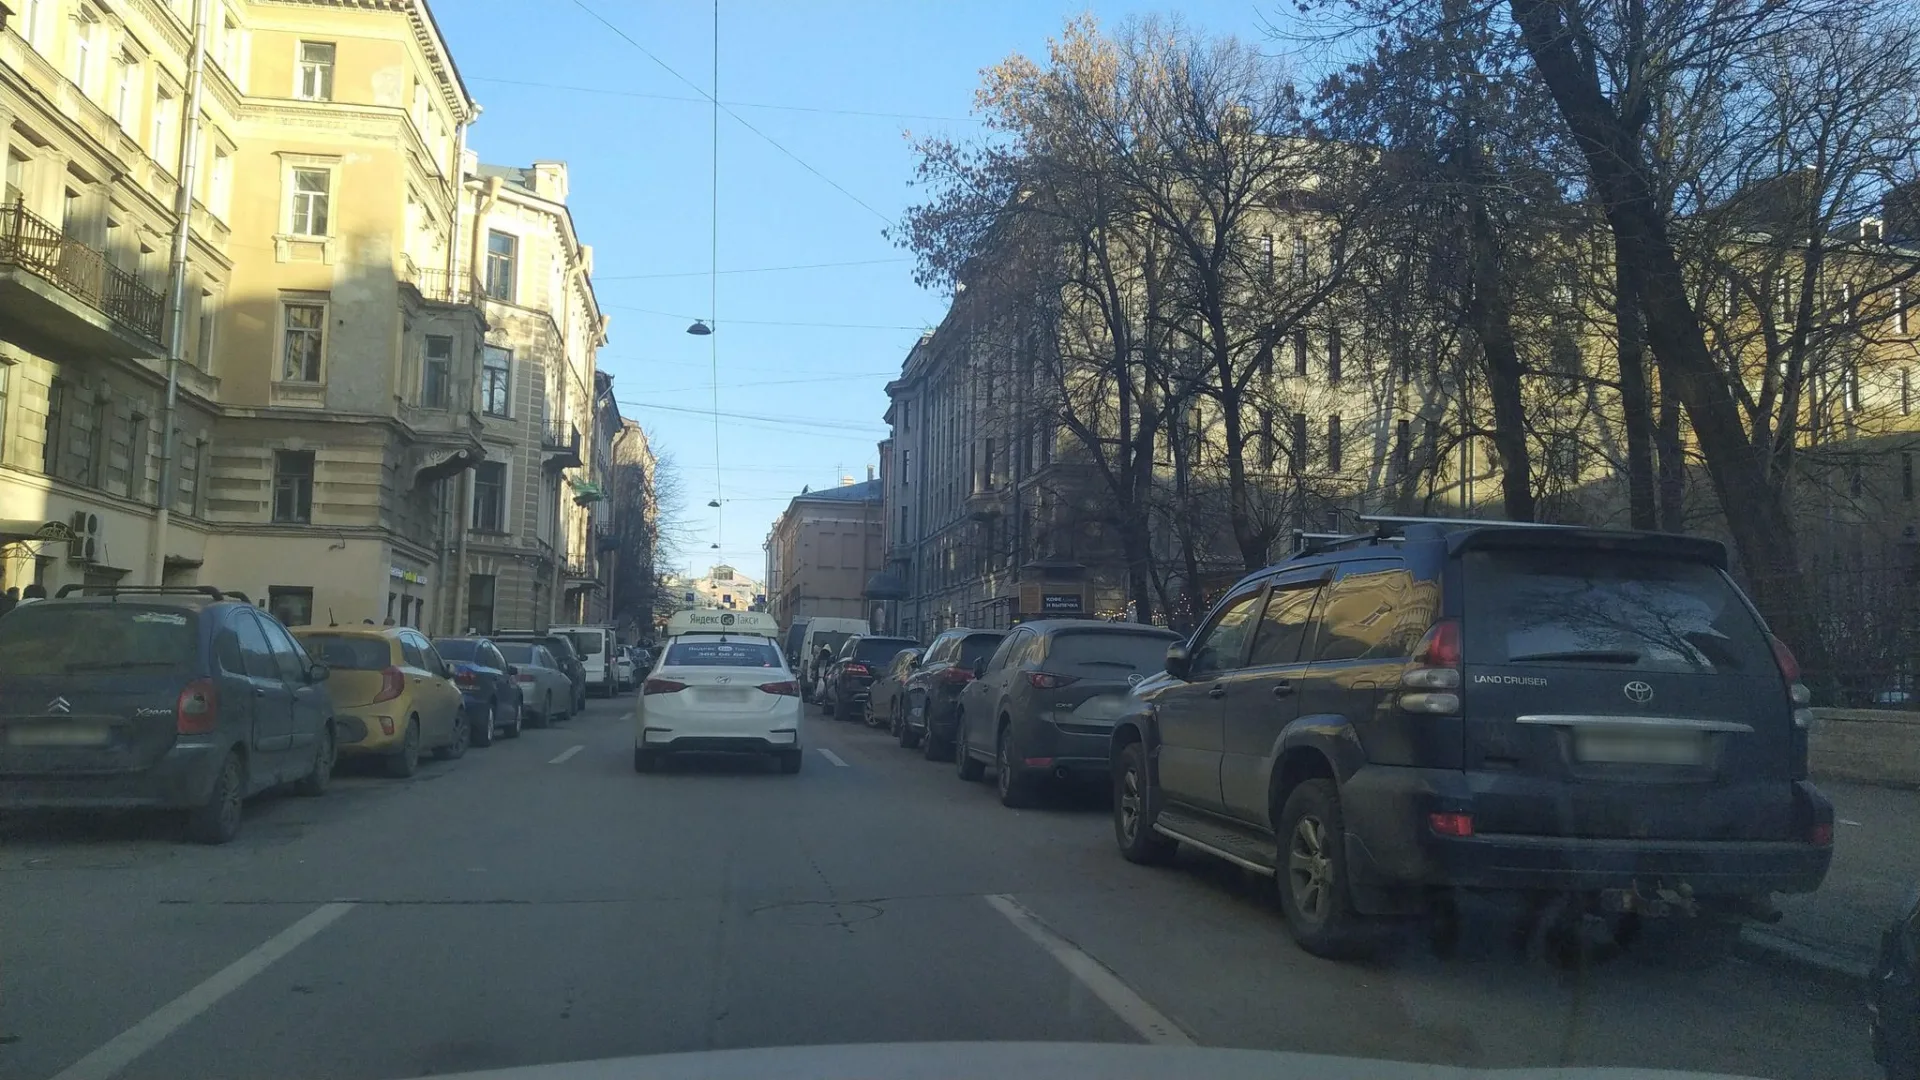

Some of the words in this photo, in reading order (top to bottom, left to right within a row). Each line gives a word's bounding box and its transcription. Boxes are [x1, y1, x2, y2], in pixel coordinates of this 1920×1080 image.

[689, 614, 719, 625] Яндекс
[723, 615, 734, 624] Go
[737, 614, 759, 625] Такси
[1474, 675, 1502, 684] LAND
[1503, 676, 1548, 686] CRUISER
